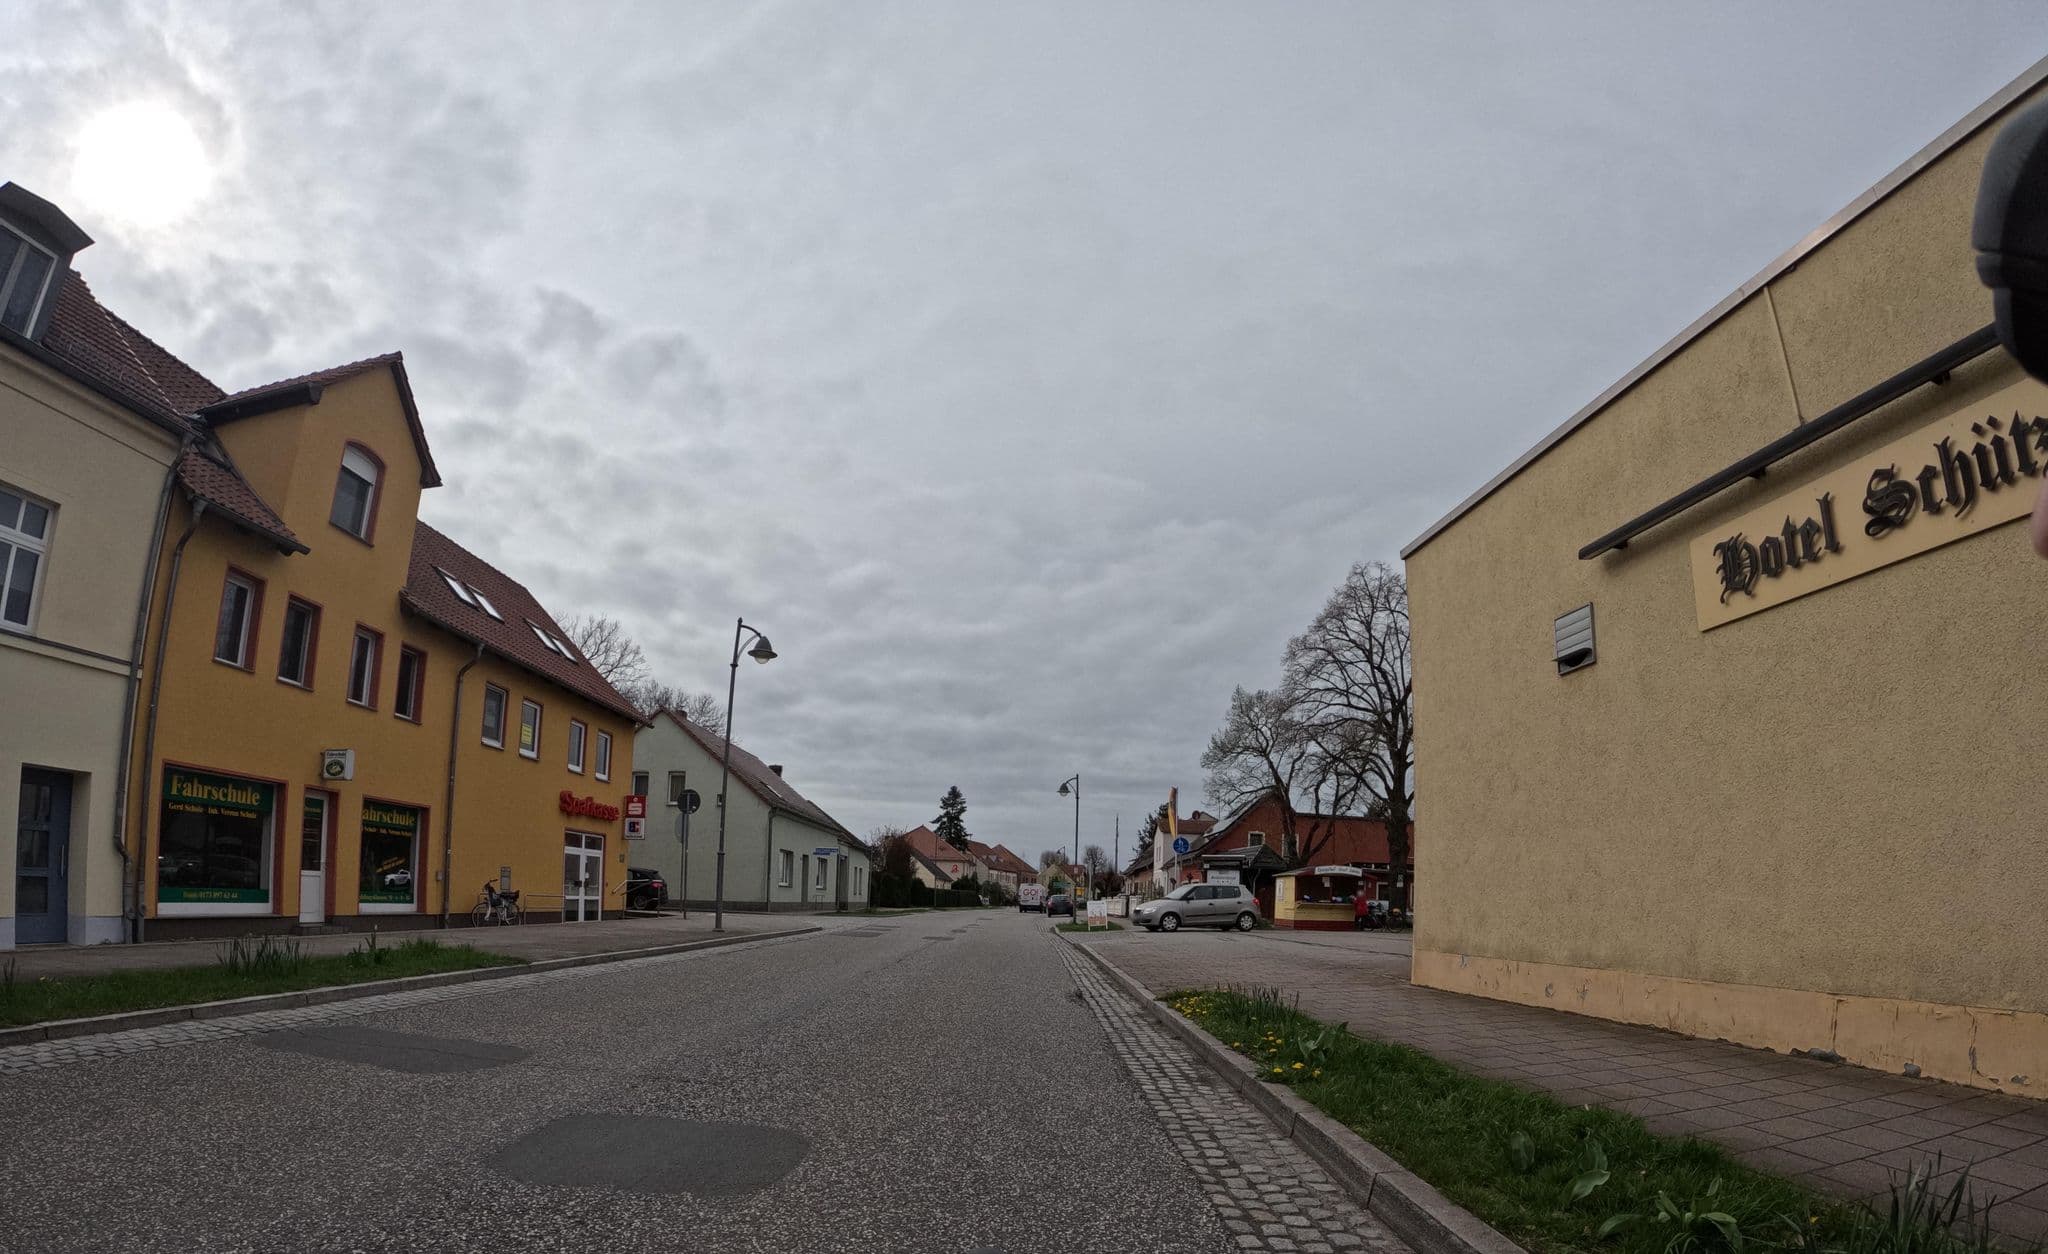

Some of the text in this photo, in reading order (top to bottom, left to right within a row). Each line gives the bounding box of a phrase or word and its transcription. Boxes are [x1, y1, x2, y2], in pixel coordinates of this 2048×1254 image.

[1713, 492, 1840, 604] Hotel
[169, 775, 260, 806] Fahrschule
[560, 791, 620, 821] Sparkasse
[1023, 888, 1040, 896] GO!
